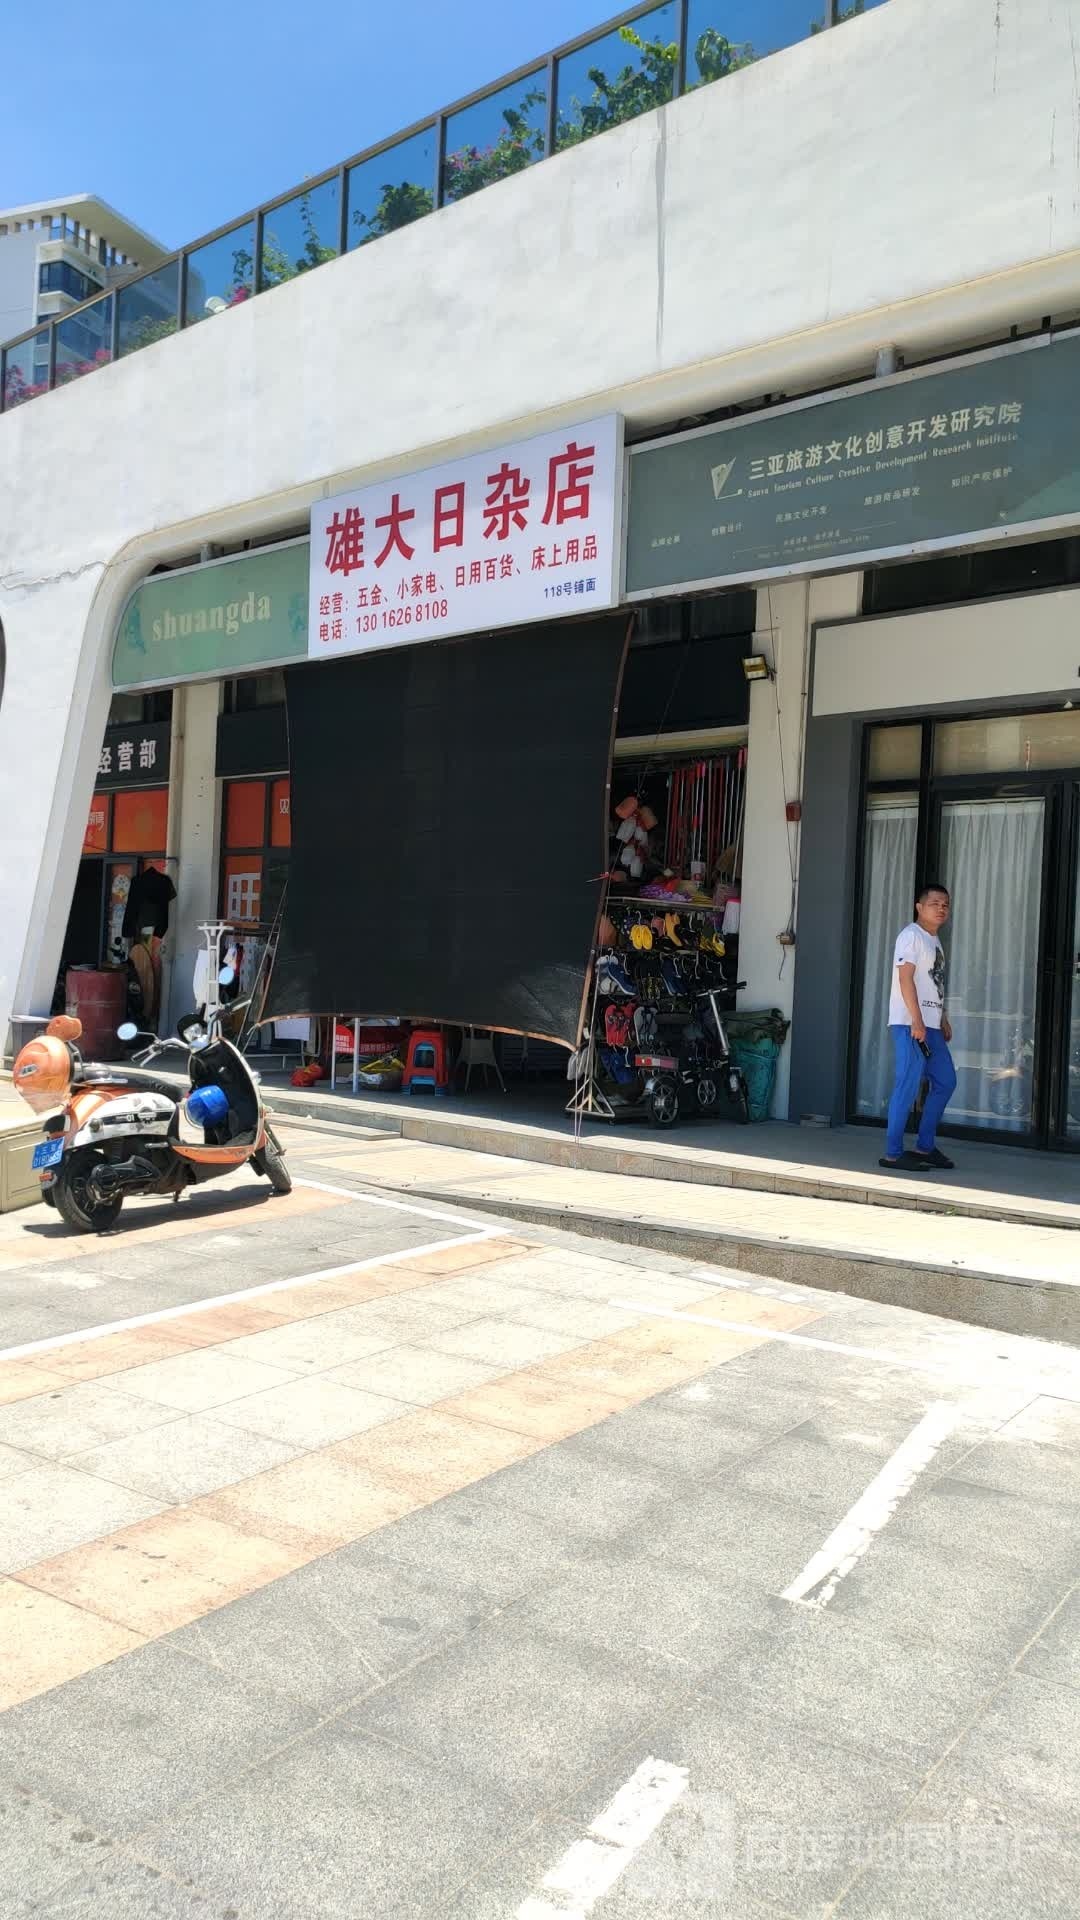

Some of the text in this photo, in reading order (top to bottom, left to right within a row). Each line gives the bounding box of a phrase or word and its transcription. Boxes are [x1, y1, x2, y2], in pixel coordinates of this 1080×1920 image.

[749, 402, 1022, 480] 三亚旅游文化创意开发研究院
[838, 465, 871, 479] Creative
[875, 450, 927, 471] Development
[932, 441, 972, 457] Research
[976, 432, 1018, 447] Institute
[325, 441, 596, 577] 雄大日杂店
[544, 577, 597, 598] 118号铺面
[152, 592, 272, 642] shuangda
